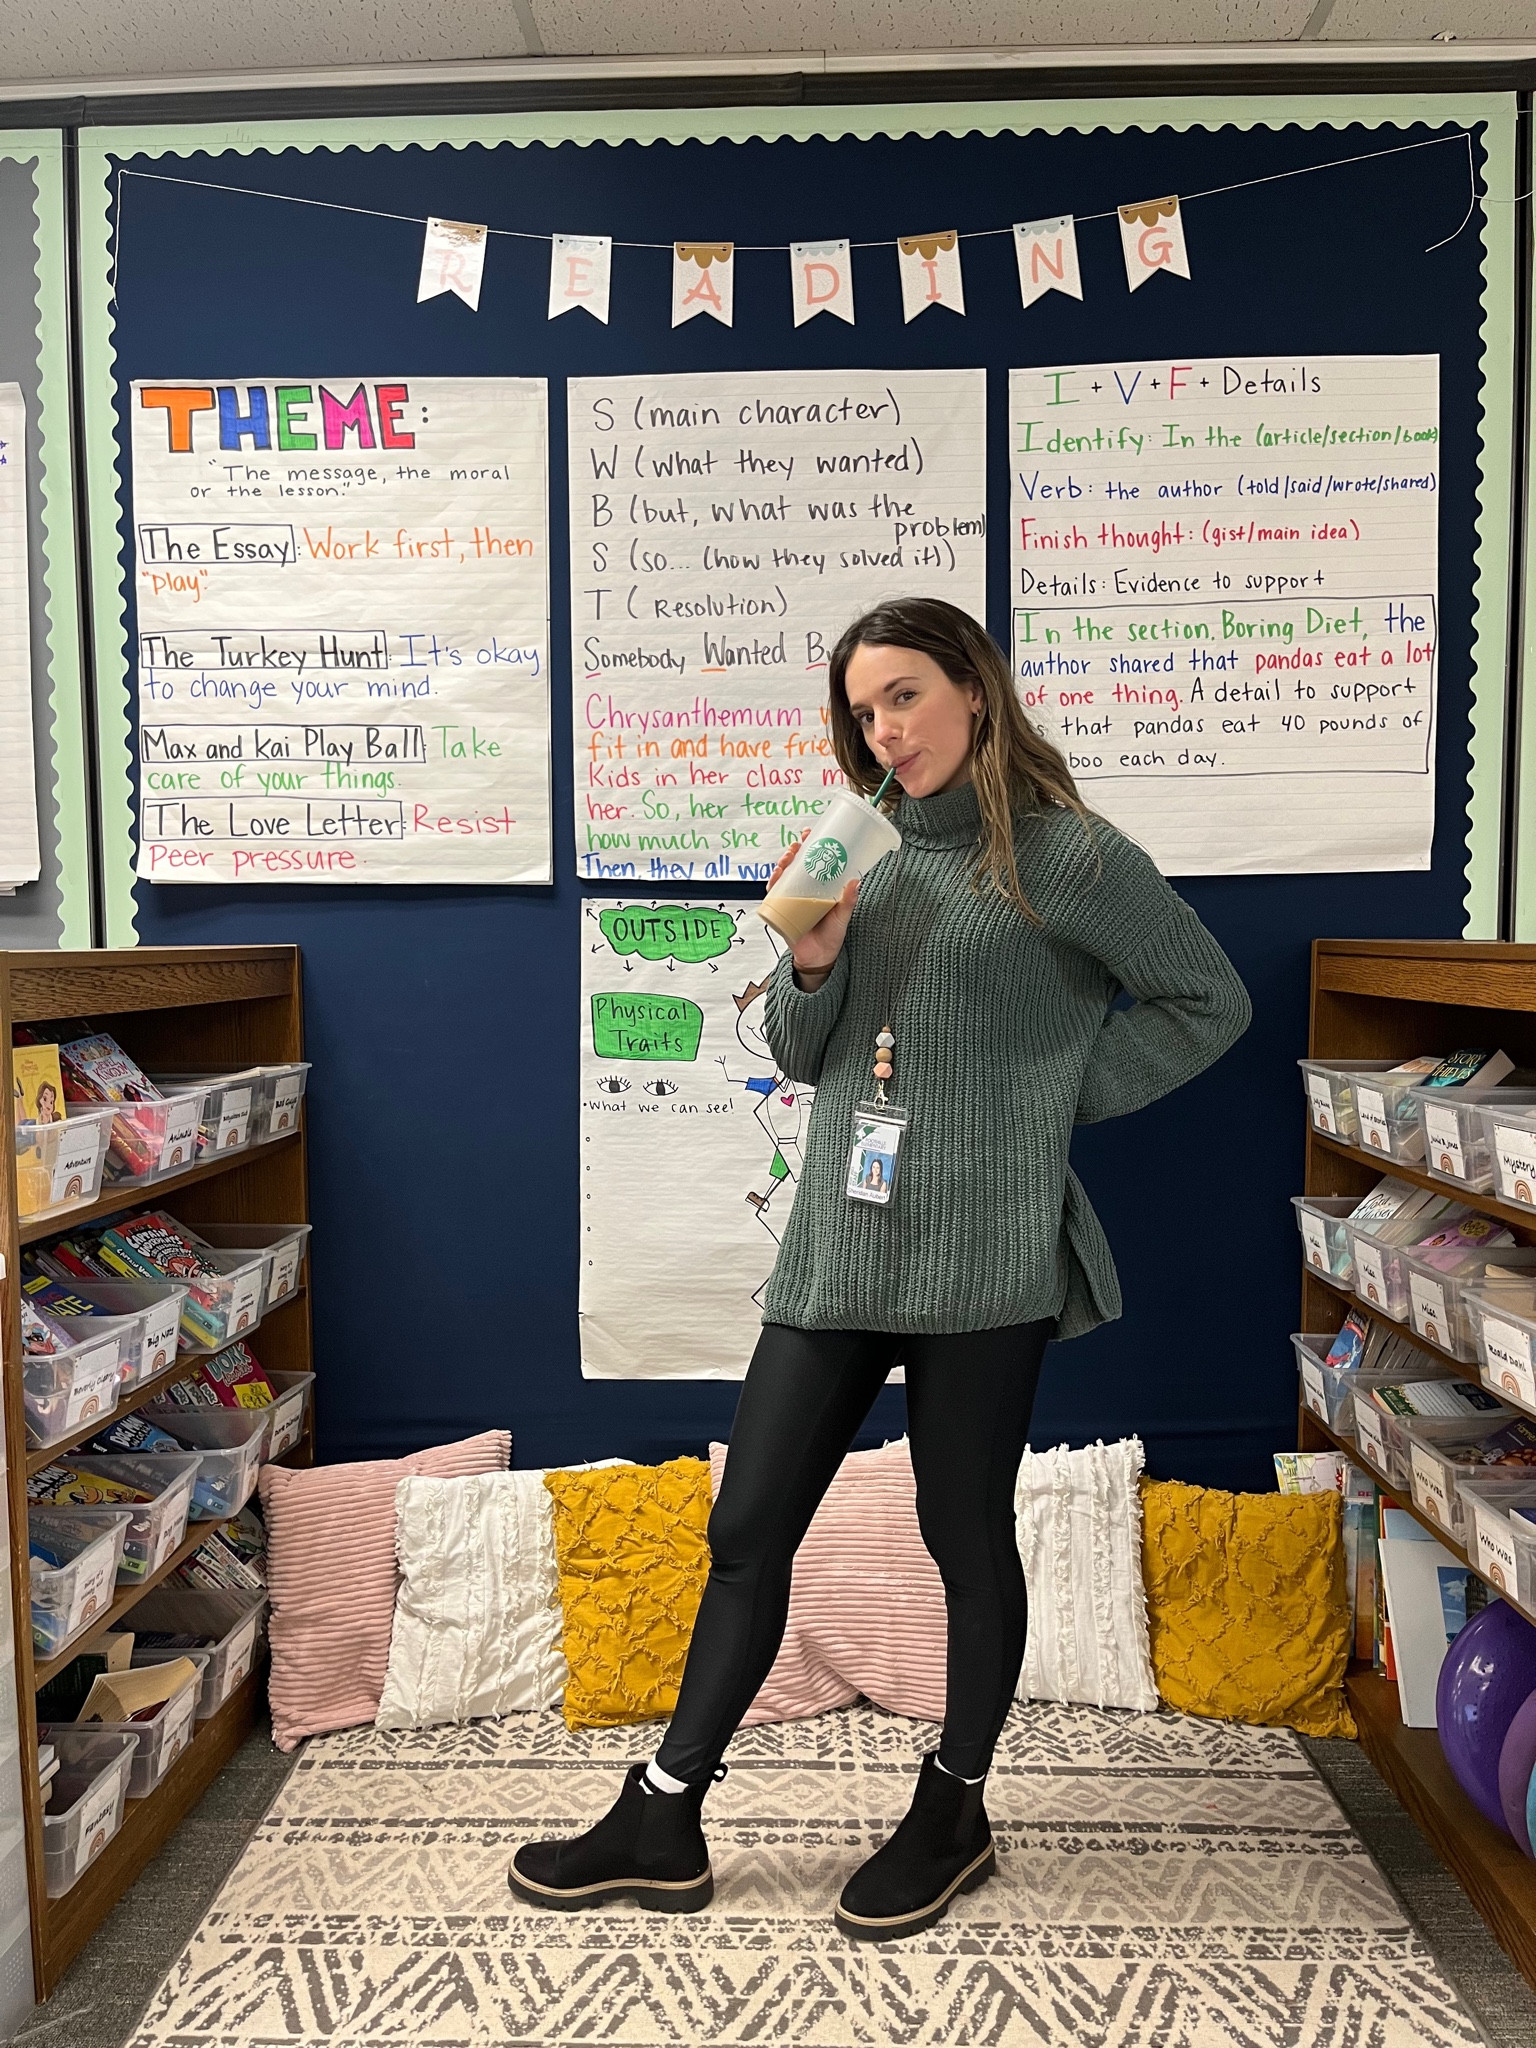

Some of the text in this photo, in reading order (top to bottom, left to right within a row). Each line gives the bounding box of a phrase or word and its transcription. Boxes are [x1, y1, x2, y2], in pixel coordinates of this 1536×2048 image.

[1044, 366, 1322, 406] I V F Details
[141, 382, 429, 453] THEME:
[594, 388, 901, 431] S (main character)
[1017, 421, 1152, 455] Identify:
[1162, 423, 1194, 448] In
[1205, 426, 1241, 447] the
[287, 466, 387, 484] message,
[396, 466, 431, 479] the
[450, 466, 509, 481] moral
[590, 445, 617, 479] W
[734, 448, 794, 480] they
[817, 437, 923, 475] wanted)
[190, 485, 211, 498] or
[227, 484, 262, 497] the
[1019, 471, 1223, 501] Verb: the author
[592, 494, 613, 527] B
[711, 495, 791, 521] what
[808, 499, 857, 520] was
[868, 494, 915, 517] the
[143, 527, 200, 560] The
[303, 526, 379, 560] Work
[393, 527, 465, 563] first,
[469, 527, 533, 558] then
[1021, 518, 1088, 550] Finish
[1097, 522, 1193, 553] thought:
[1310, 519, 1360, 540] idea)
[593, 542, 608, 573] S
[771, 548, 825, 574] they
[839, 545, 903, 568] solved
[1021, 568, 1325, 597] Details: Evidence to support
[584, 588, 612, 620] T
[1017, 603, 1425, 644] In the Boring Diet, the
[143, 637, 194, 667] The
[211, 637, 307, 675] Turkey
[399, 634, 462, 667] It's
[476, 637, 540, 676] okay
[585, 637, 685, 675] Somebody
[703, 632, 787, 666] Wanted
[1020, 640, 1435, 678] author shared that pandas eat a lot
[145, 667, 438, 709] to change your mind.
[1025, 677, 1417, 711] of one thing. A detail to support
[587, 693, 801, 733] Chrysanthemum
[1061, 716, 1113, 736] that
[1134, 714, 1205, 738] pandas
[1222, 716, 1261, 733] eat
[1281, 715, 1305, 732] 40
[1319, 714, 1388, 735] pounds
[1403, 711, 1423, 728] of
[143, 728, 196, 760] Max
[207, 734, 243, 759] and
[302, 727, 354, 765] Play
[431, 726, 502, 758] Take
[588, 732, 836, 762] fit in and have frie
[1120, 751, 1224, 769] each day.
[148, 761, 402, 798] care of your things.
[589, 763, 641, 788] Kids
[655, 768, 677, 785] in
[690, 762, 729, 786] her
[747, 762, 802, 787] class
[147, 803, 214, 835] The
[230, 802, 291, 836] Love
[414, 804, 516, 835] Resist
[587, 794, 635, 820] her.
[642, 788, 681, 823] So,
[690, 794, 728, 819] her
[587, 825, 630, 852] how
[640, 826, 709, 851] much
[721, 828, 759, 849] she
[233, 846, 368, 876] pressure.
[704, 854, 730, 879] all
[613, 917, 722, 942] OUTSIDE
[596, 997, 687, 1027] Physical
[609, 1029, 683, 1052] Traits
[1448, 1050, 1486, 1067] STORY
[638, 1105, 659, 1113] we
[671, 1104, 698, 1113] can
[706, 1098, 734, 1114] see!
[205, 1342, 251, 1382] DORK
